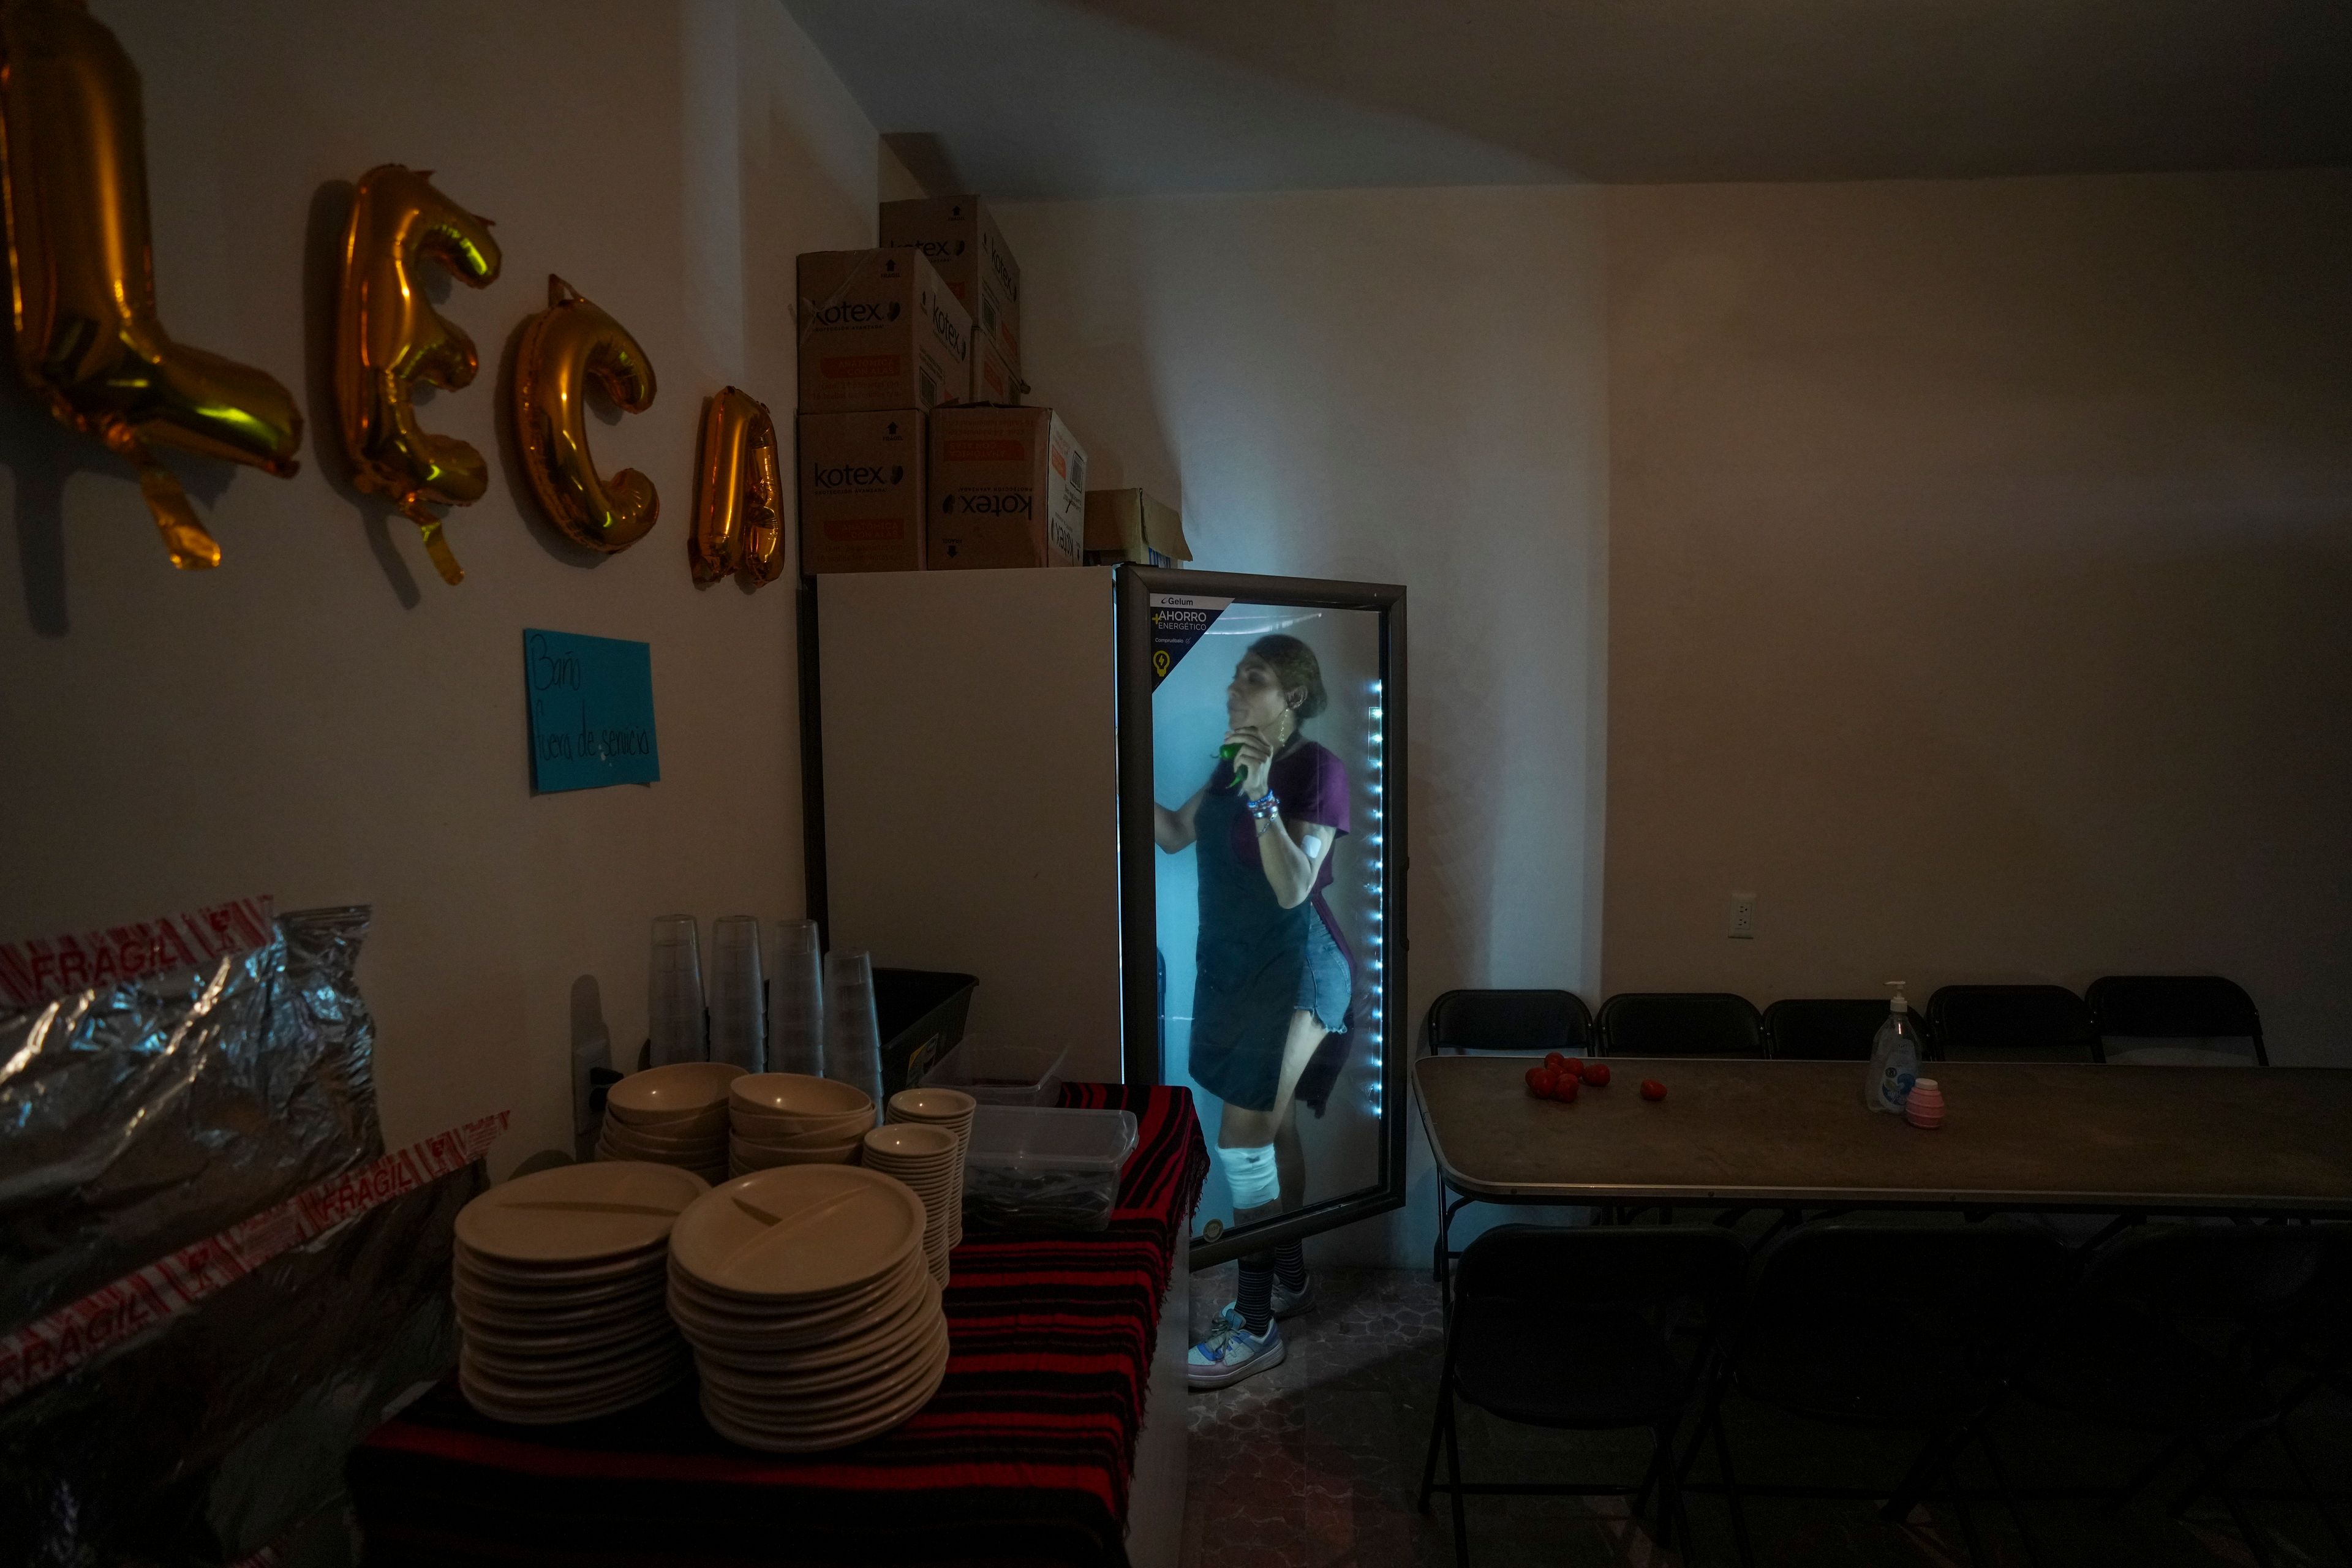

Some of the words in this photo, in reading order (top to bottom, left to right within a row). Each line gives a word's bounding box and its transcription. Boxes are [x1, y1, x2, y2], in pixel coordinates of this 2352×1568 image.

[891, 240, 949, 257] tex
[991, 237, 1011, 294] kotex
[933, 293, 960, 354] kotex
[815, 462, 885, 489] kotex
[960, 494, 1033, 521] kotex
[1158, 611, 1207, 622] AHORRO
[1167, 597, 1193, 606] Gelum
[1158, 622, 1207, 631] ENERGÉTICO
[530, 633, 581, 691] Baño
[578, 698, 596, 758] de
[601, 725, 650, 758] servicio
[31, 933, 178, 992] FRAGIL
[323, 1162, 413, 1215] FRAGIL
